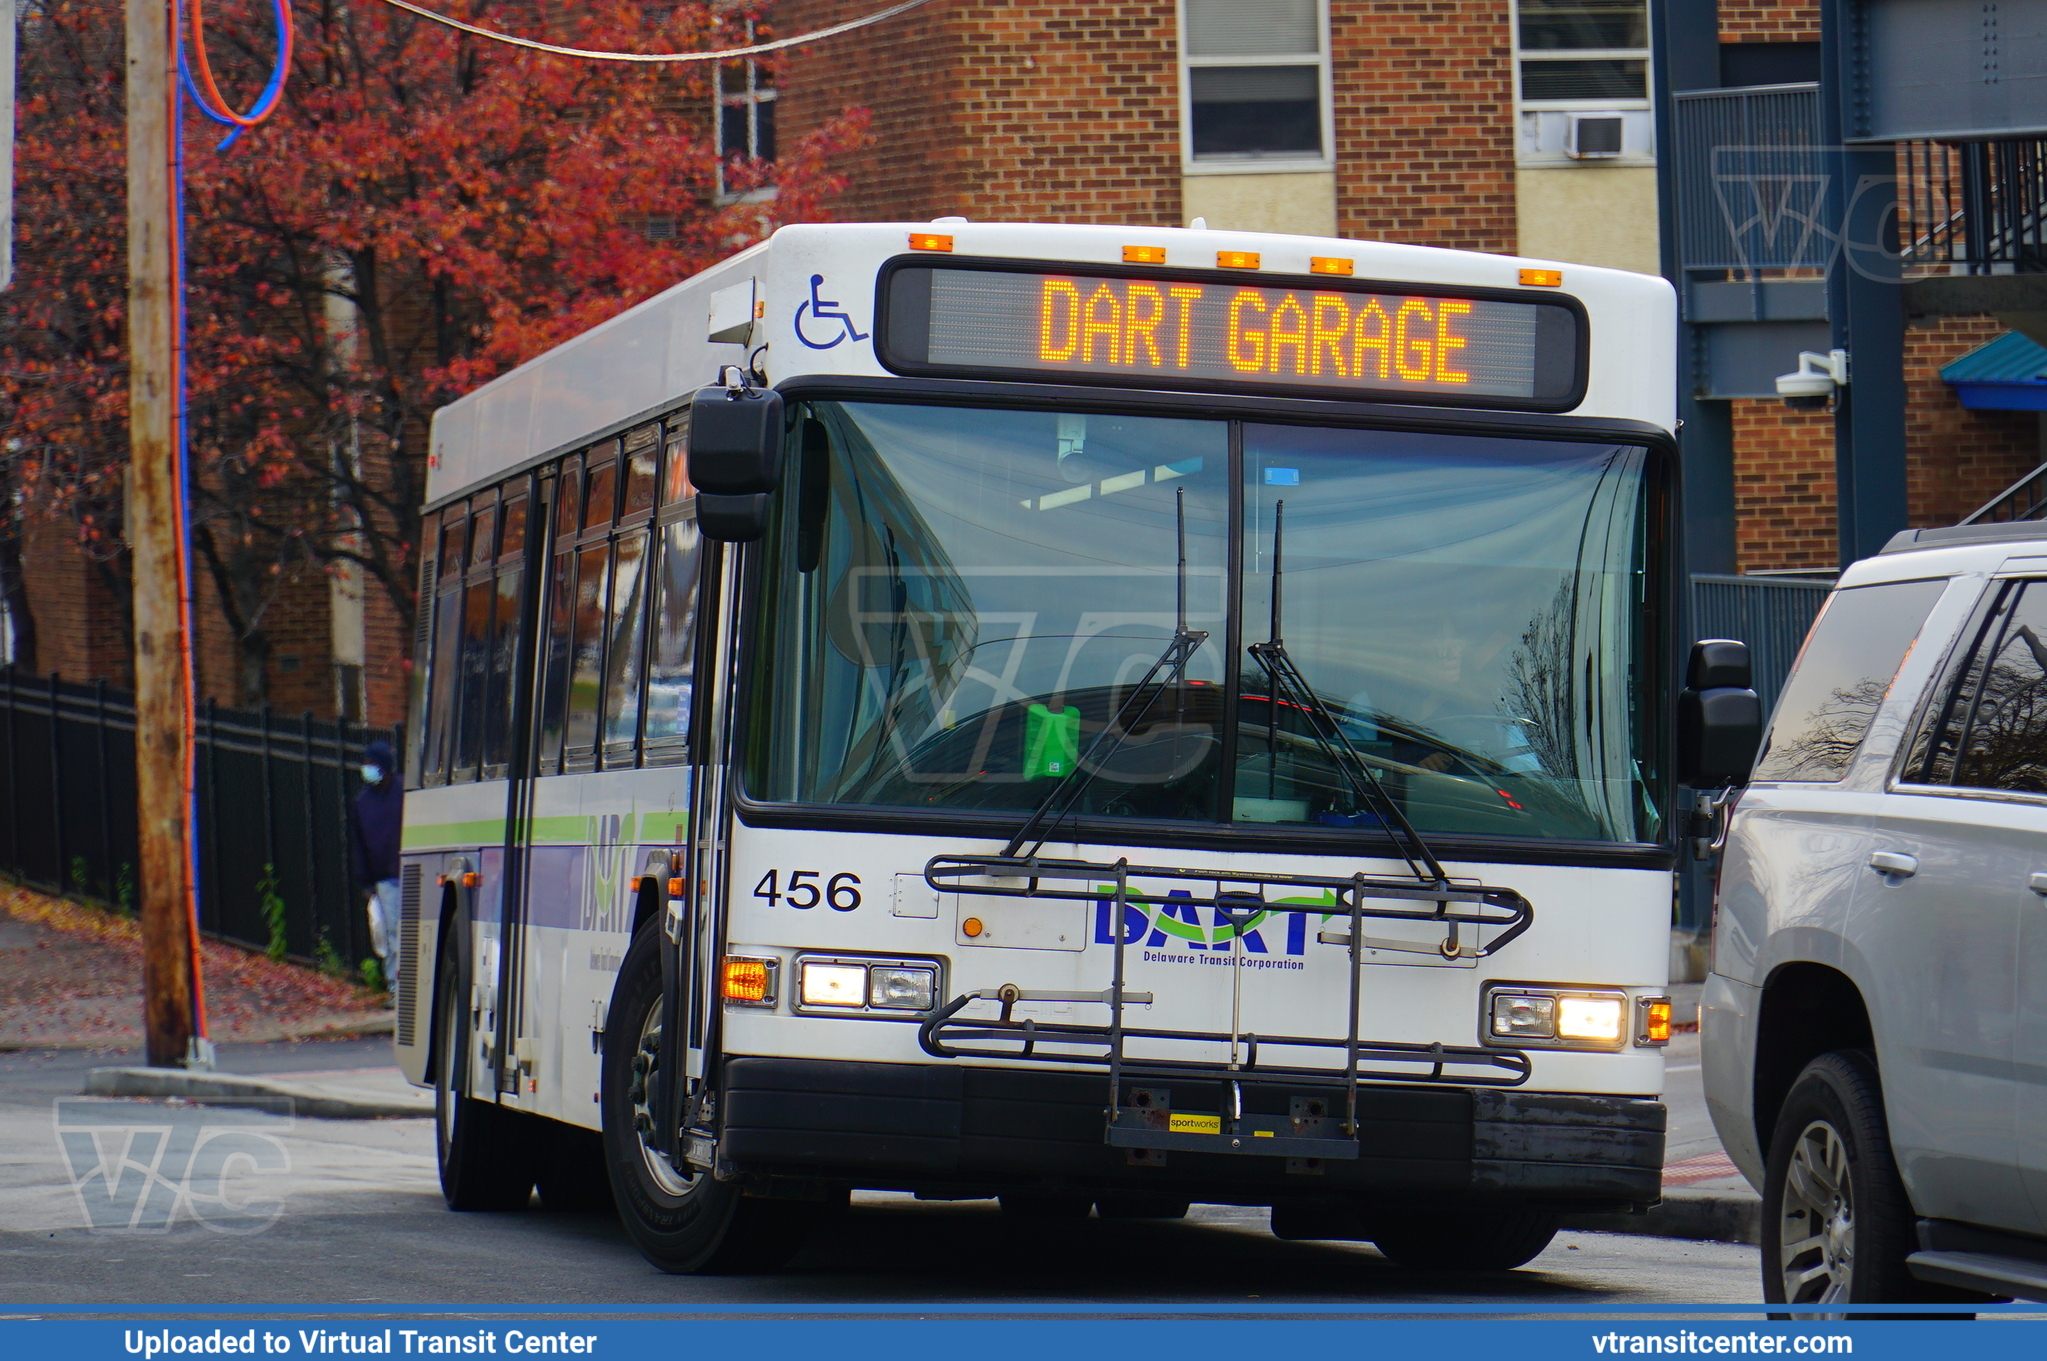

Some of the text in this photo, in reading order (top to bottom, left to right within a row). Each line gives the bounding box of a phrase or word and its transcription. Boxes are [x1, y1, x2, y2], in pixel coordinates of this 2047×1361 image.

[1039, 279, 1472, 383] DART GARAGE
[753, 868, 862, 912] 456
[1094, 884, 1337, 956] DART
[1143, 951, 1304, 970] Delaware Transit Corporation
[1170, 1118, 1219, 1129] sportworks
